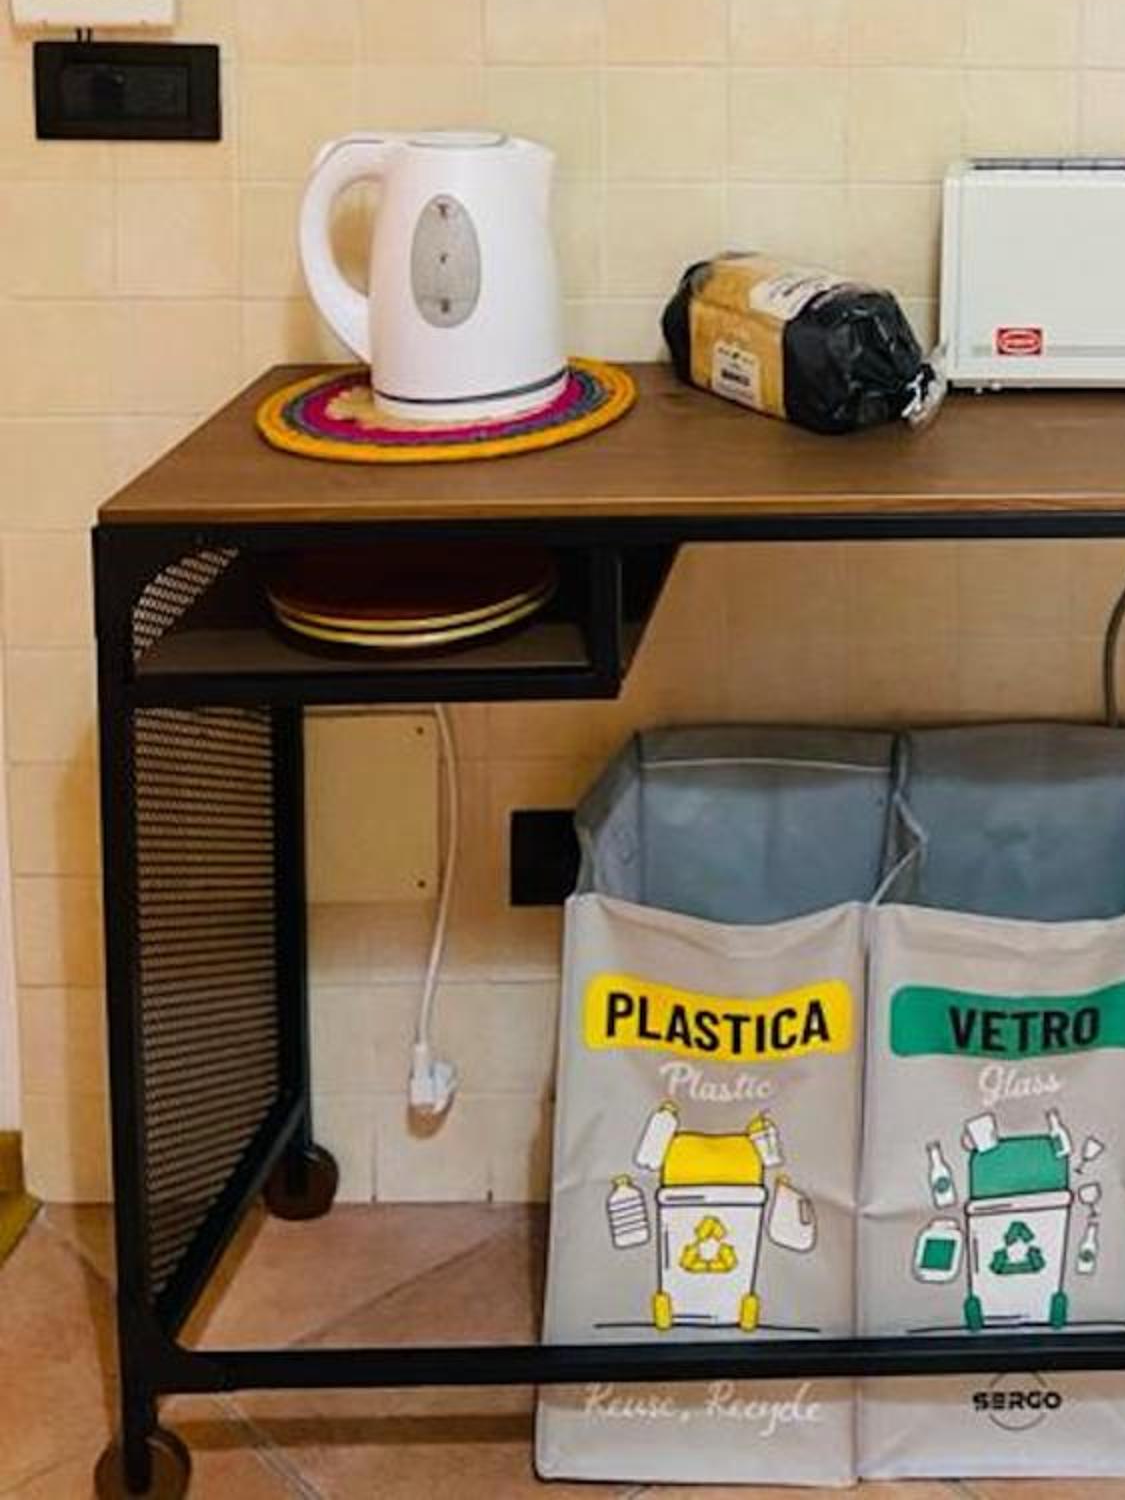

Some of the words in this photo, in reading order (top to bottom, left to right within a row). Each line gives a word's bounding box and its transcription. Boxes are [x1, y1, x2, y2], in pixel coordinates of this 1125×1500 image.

[605, 991, 831, 1055] PLASTICA
[948, 1005, 1100, 1054] VETRO
[659, 1059, 772, 1102] Plastic
[978, 1063, 1062, 1107] Glass
[703, 1379, 822, 1438] Recycle
[972, 1390, 1062, 1411] SERGO
